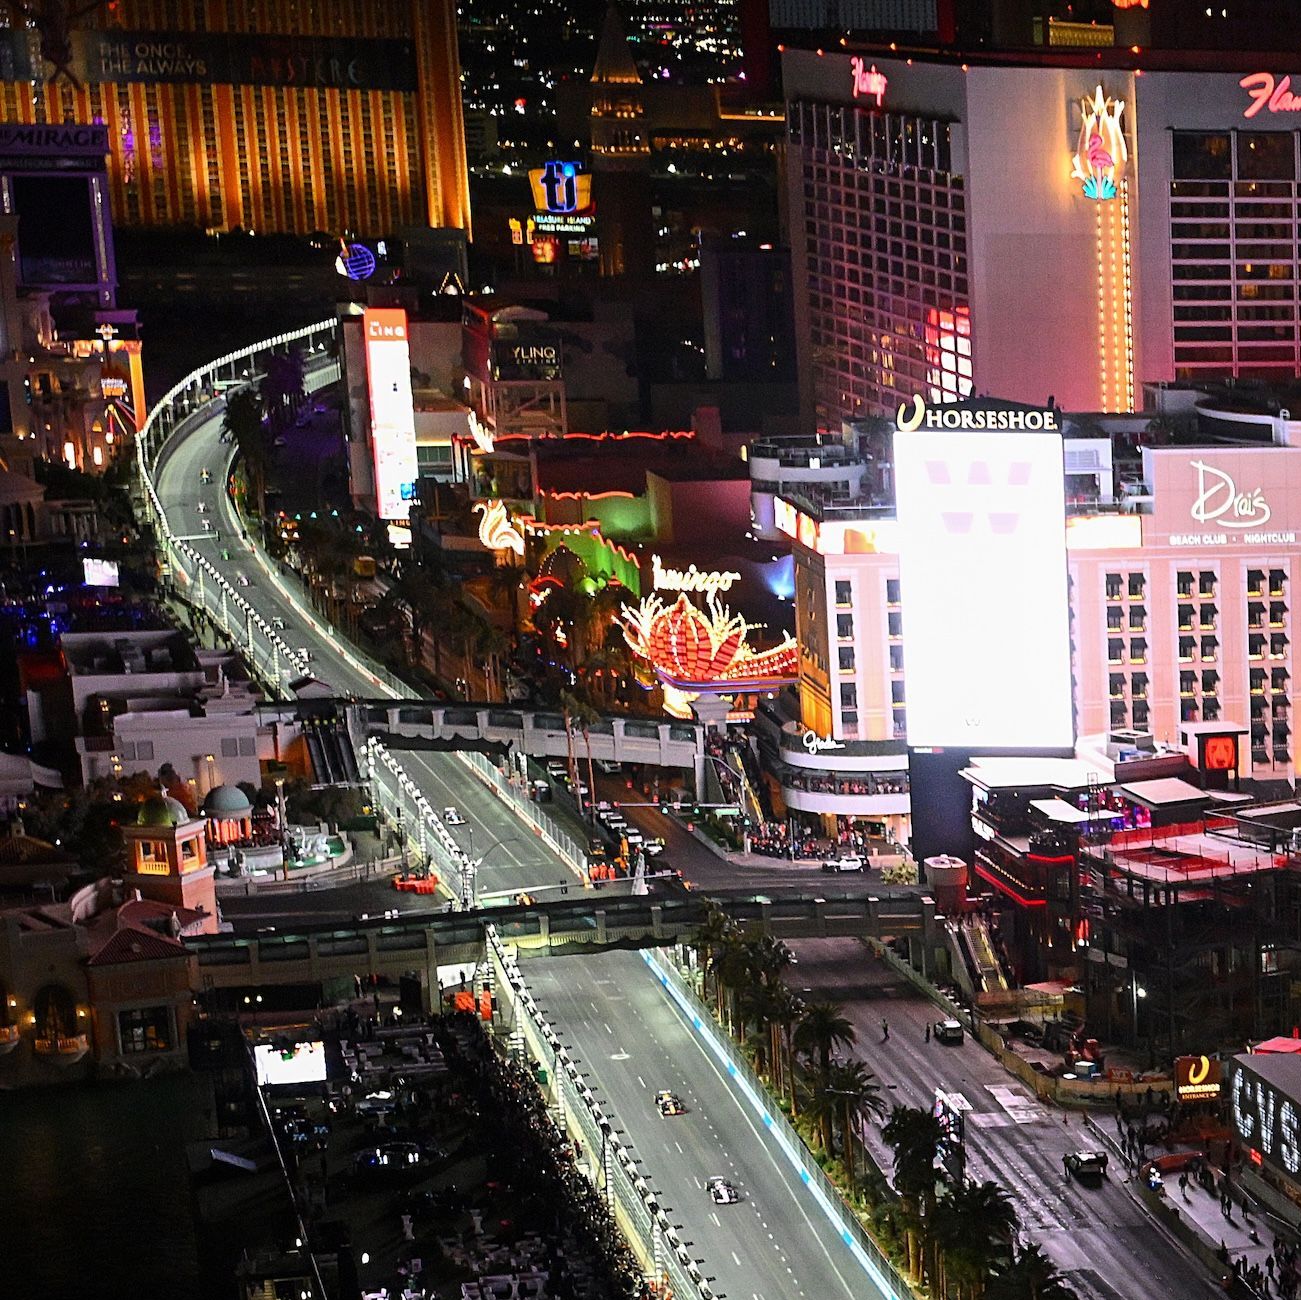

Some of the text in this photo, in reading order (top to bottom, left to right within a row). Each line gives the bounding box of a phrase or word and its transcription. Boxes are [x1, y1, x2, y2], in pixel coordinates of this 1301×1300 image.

[101, 60, 207, 76] THE ALWAYS
[9, 130, 104, 146] MIRAGE
[369, 326, 405, 337] LINQ
[1190, 460, 1271, 528] Drai's
[1169, 533, 1296, 545] BEACH CLUB NIGHTCLUB
[1233, 1068, 1301, 1173] CVS
